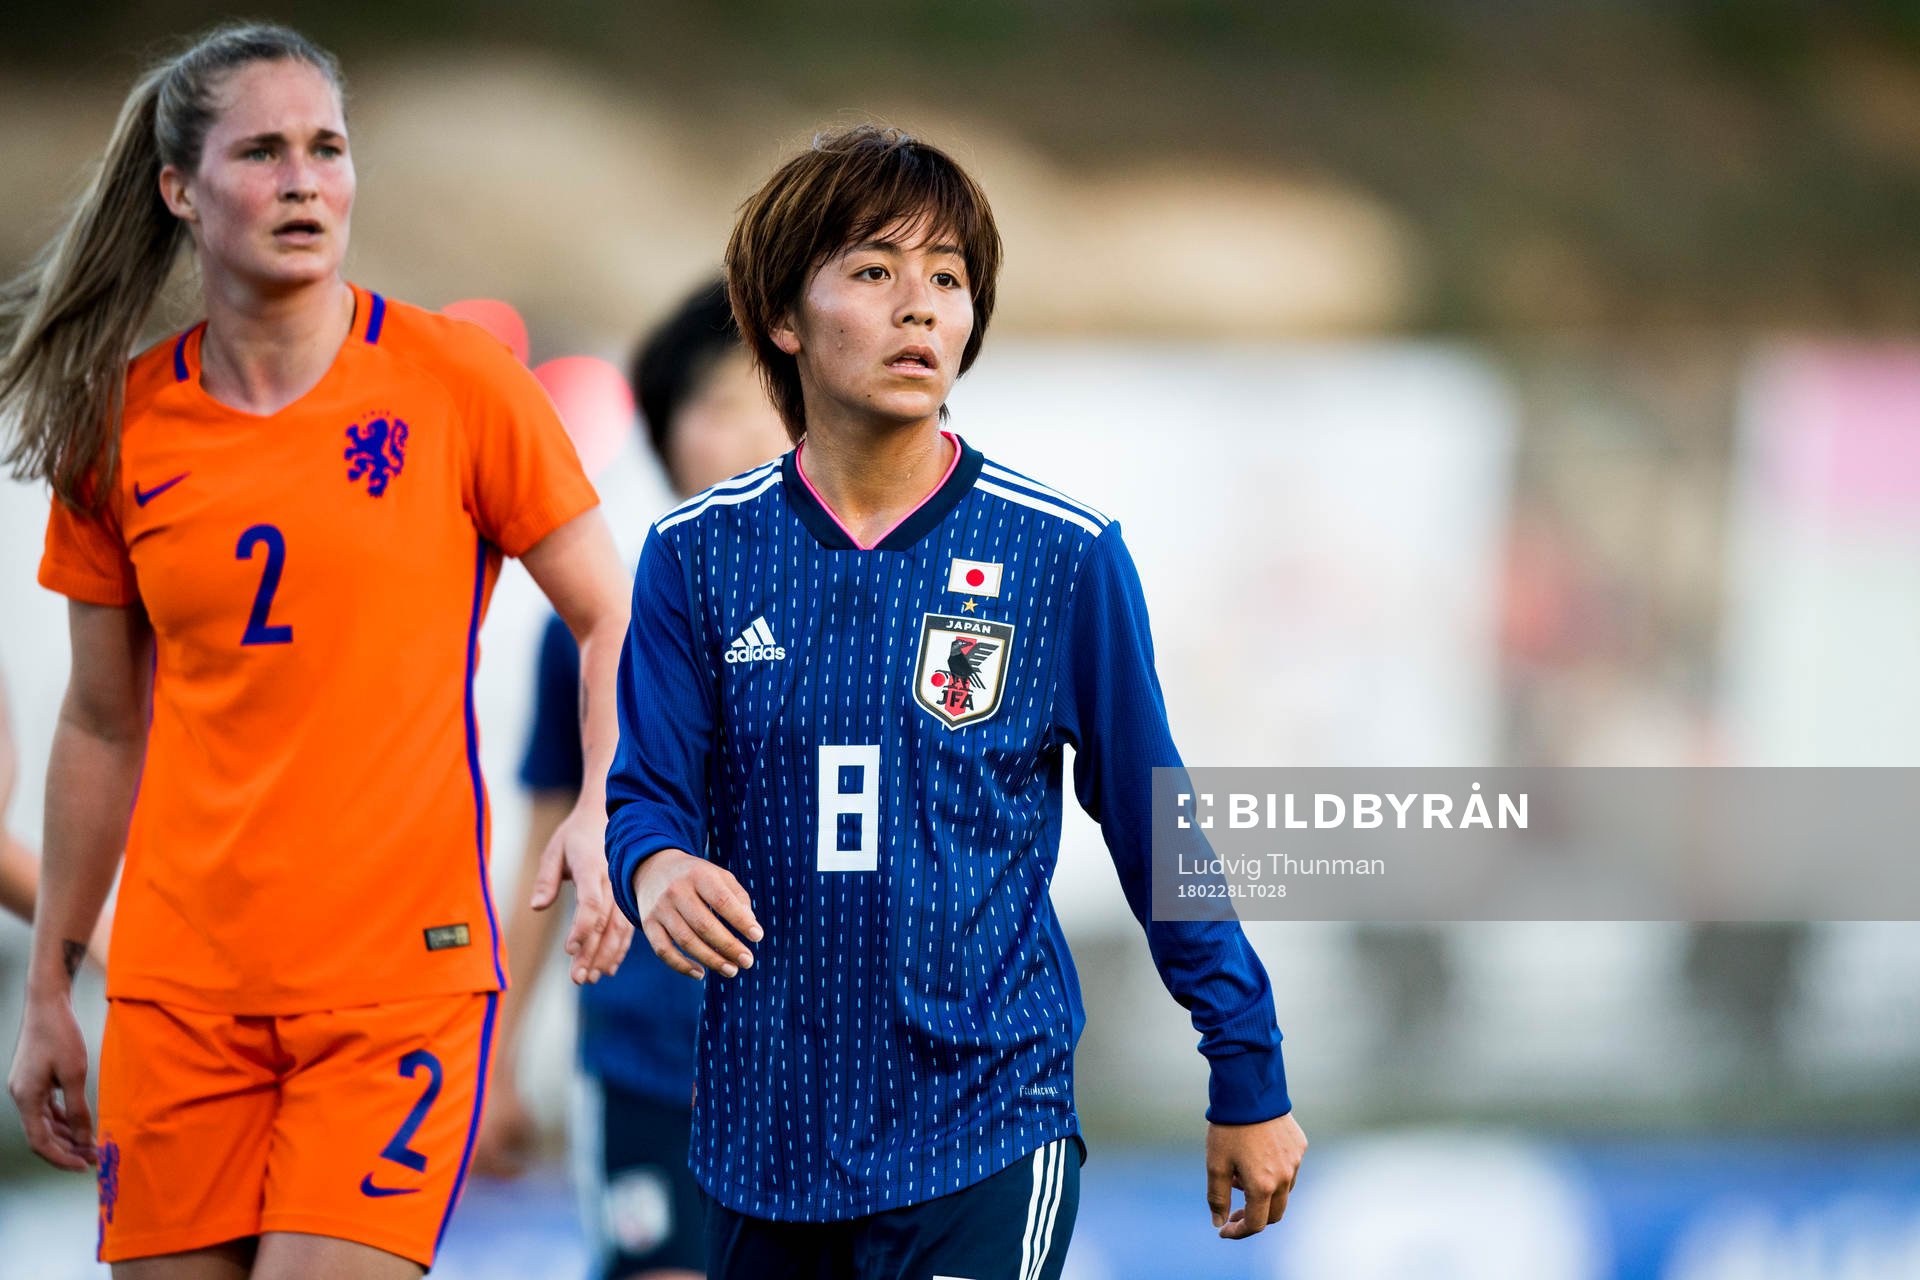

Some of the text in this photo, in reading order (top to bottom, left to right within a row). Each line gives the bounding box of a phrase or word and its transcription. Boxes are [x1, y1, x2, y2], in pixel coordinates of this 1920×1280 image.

[236, 524, 293, 645] 2
[724, 645, 785, 663] adidas
[946, 620, 991, 634] JAPAN
[936, 689, 974, 711] JFA
[817, 745, 880, 872] 8
[380, 1049, 443, 1172] 2
